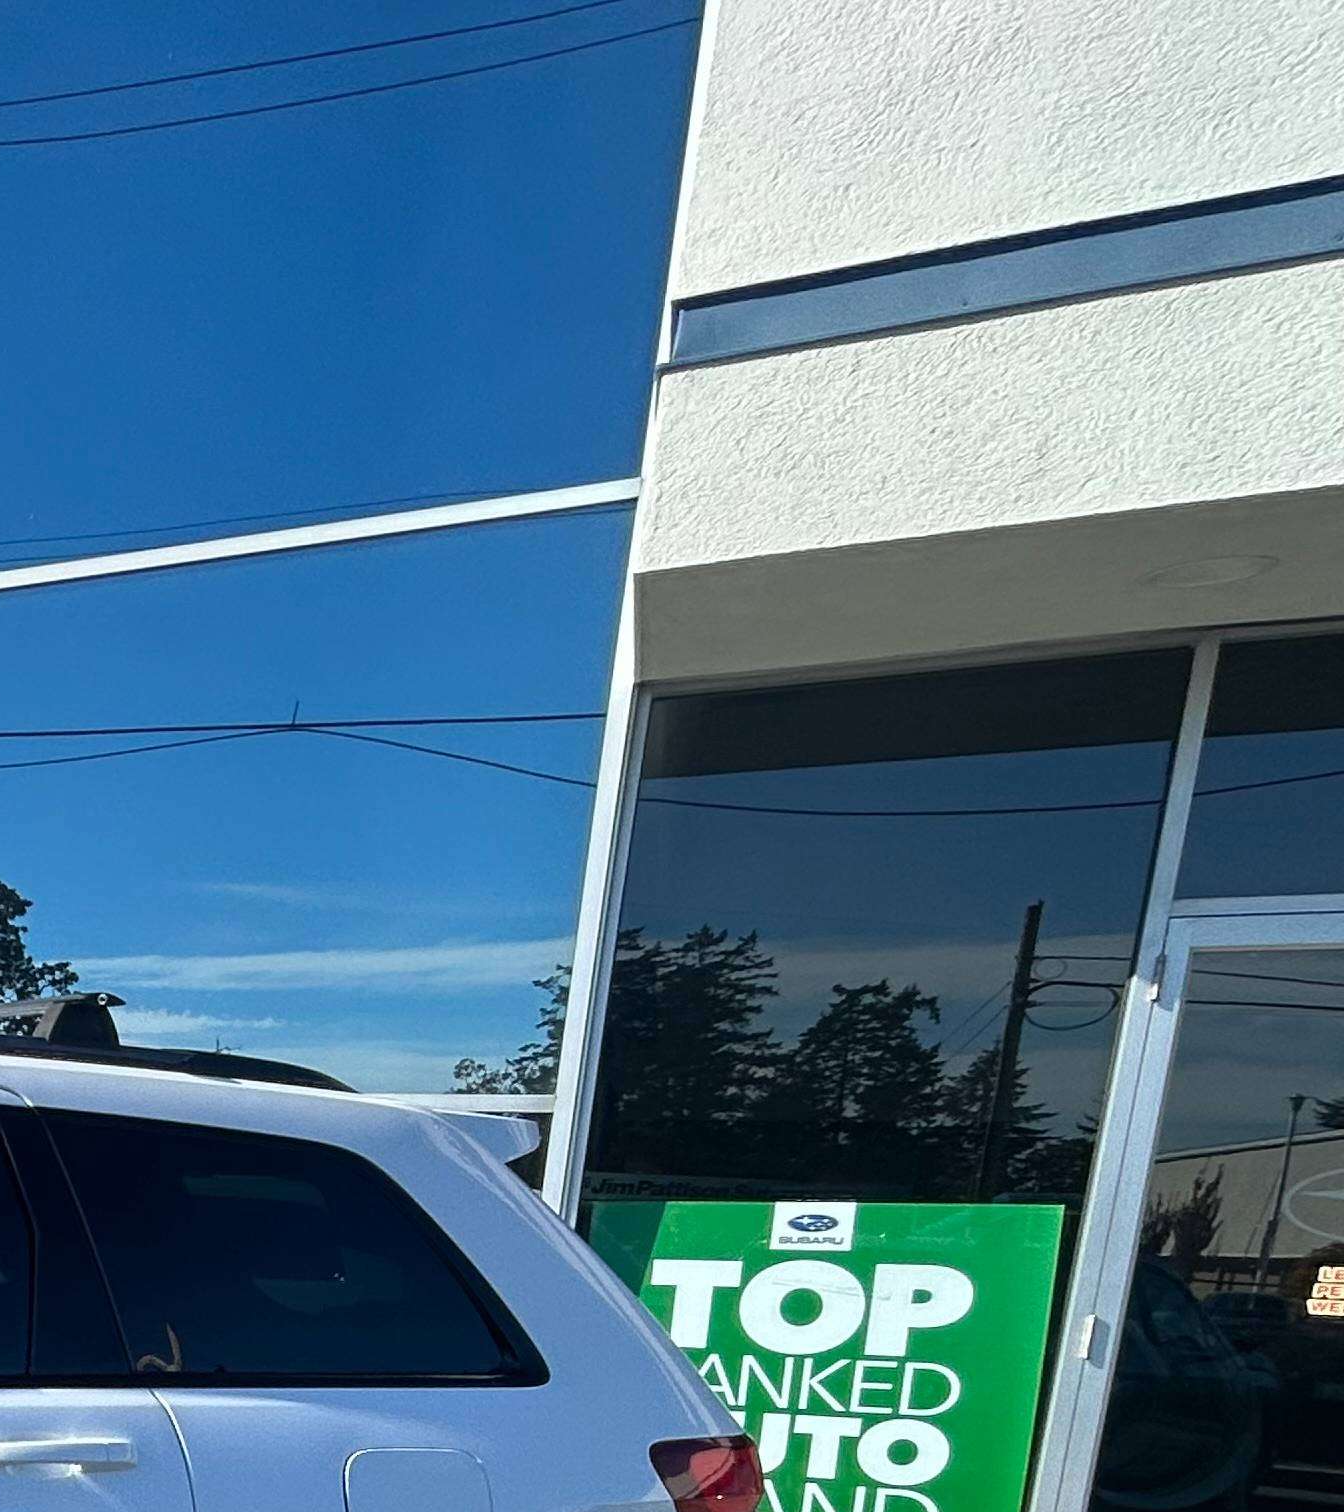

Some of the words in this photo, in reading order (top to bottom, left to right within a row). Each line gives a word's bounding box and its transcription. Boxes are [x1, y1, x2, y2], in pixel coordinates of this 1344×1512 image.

[778, 1236, 844, 1245] SUBARU
[650, 1258, 975, 1357] TOP
[698, 1353, 962, 1416] ANKED
[732, 1410, 951, 1487] UTO
